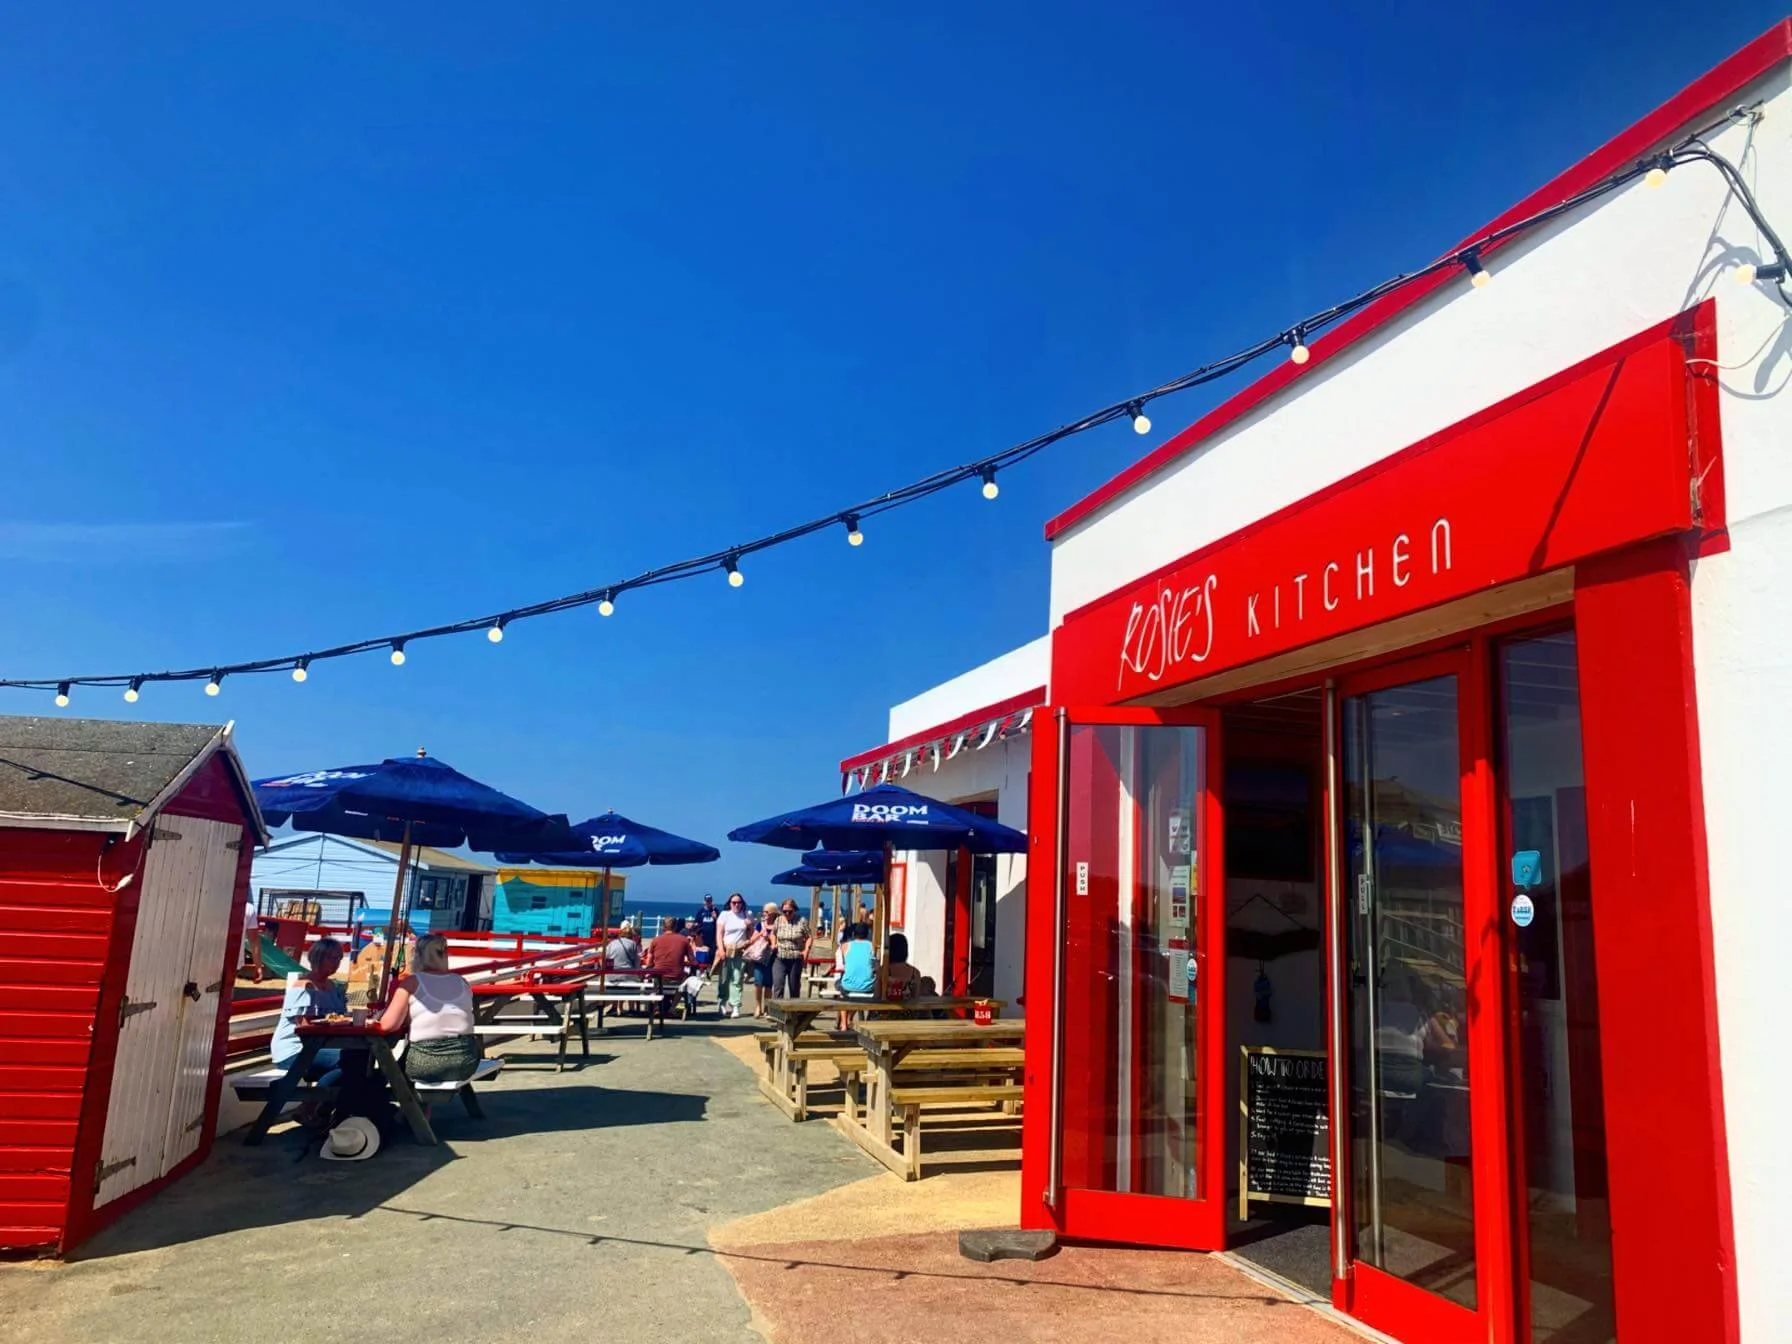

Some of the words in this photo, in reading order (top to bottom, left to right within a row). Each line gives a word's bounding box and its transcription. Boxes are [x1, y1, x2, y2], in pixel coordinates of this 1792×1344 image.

[1118, 573, 1217, 692] ROSIE'S
[1247, 518, 1452, 638] KITCHEN
[852, 812, 902, 823] BAR
[854, 803, 928, 816] DOOM
[1250, 1055, 1278, 1077] HOW
[1278, 1058, 1295, 1078] TO
[1296, 1060, 1326, 1081] ORDE
